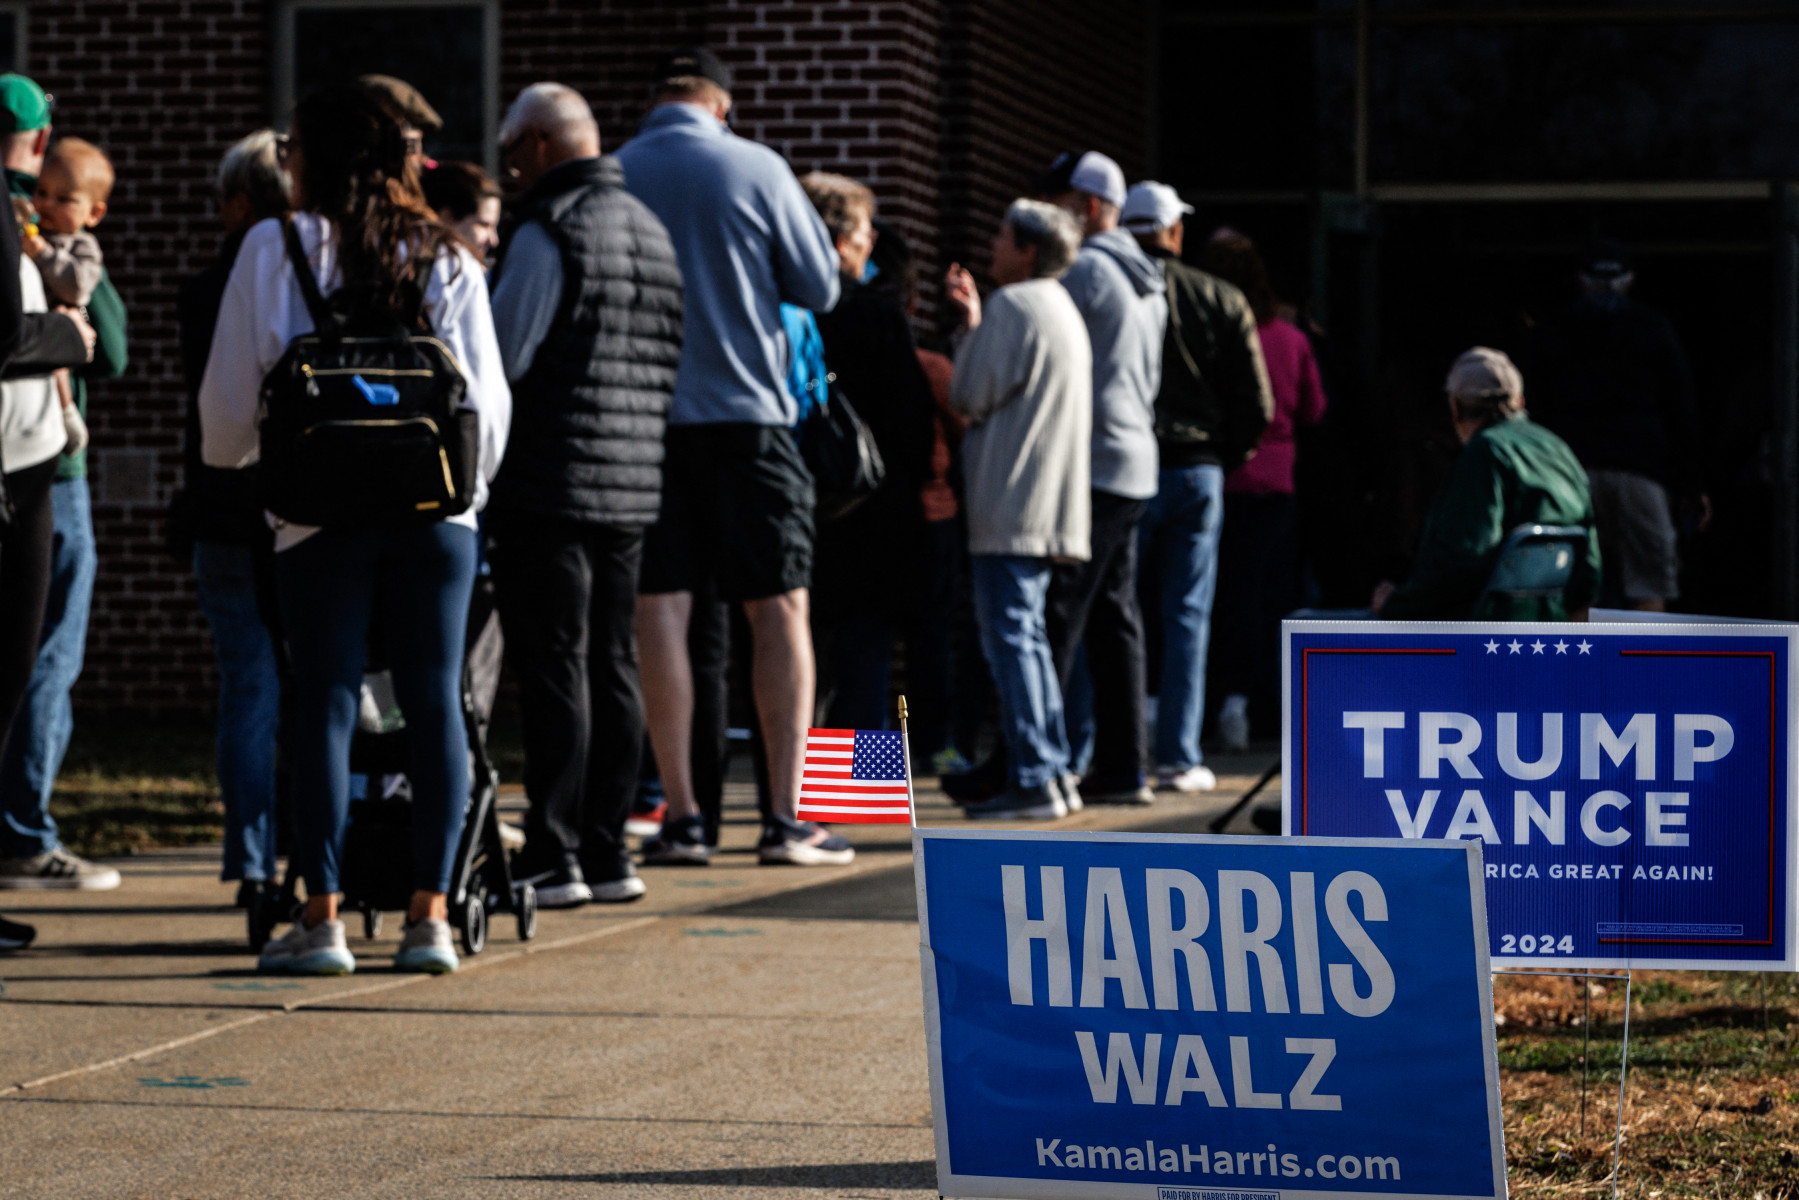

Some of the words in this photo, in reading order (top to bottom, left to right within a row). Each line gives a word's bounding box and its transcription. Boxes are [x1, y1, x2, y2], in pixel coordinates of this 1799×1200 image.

[1342, 711, 1735, 781] TRUMP
[1384, 789, 1691, 848] VANCE
[1485, 863, 1540, 880] RICA
[1549, 863, 1624, 880] GREAT
[1632, 864, 1714, 881] AGAIN!
[1001, 864, 1396, 1018] HARRIS
[1500, 934, 1575, 954] 2024
[1074, 1031, 1342, 1111] WALZ
[1035, 1137, 1401, 1182] KamalaHarris.com
[1161, 1190, 1178, 1200] PAID
[1178, 1190, 1191, 1200] FOR
[1192, 1191, 1201, 1200] BY
[1202, 1191, 1226, 1200] HARRIS
[1227, 1192, 1240, 1200] FOR
